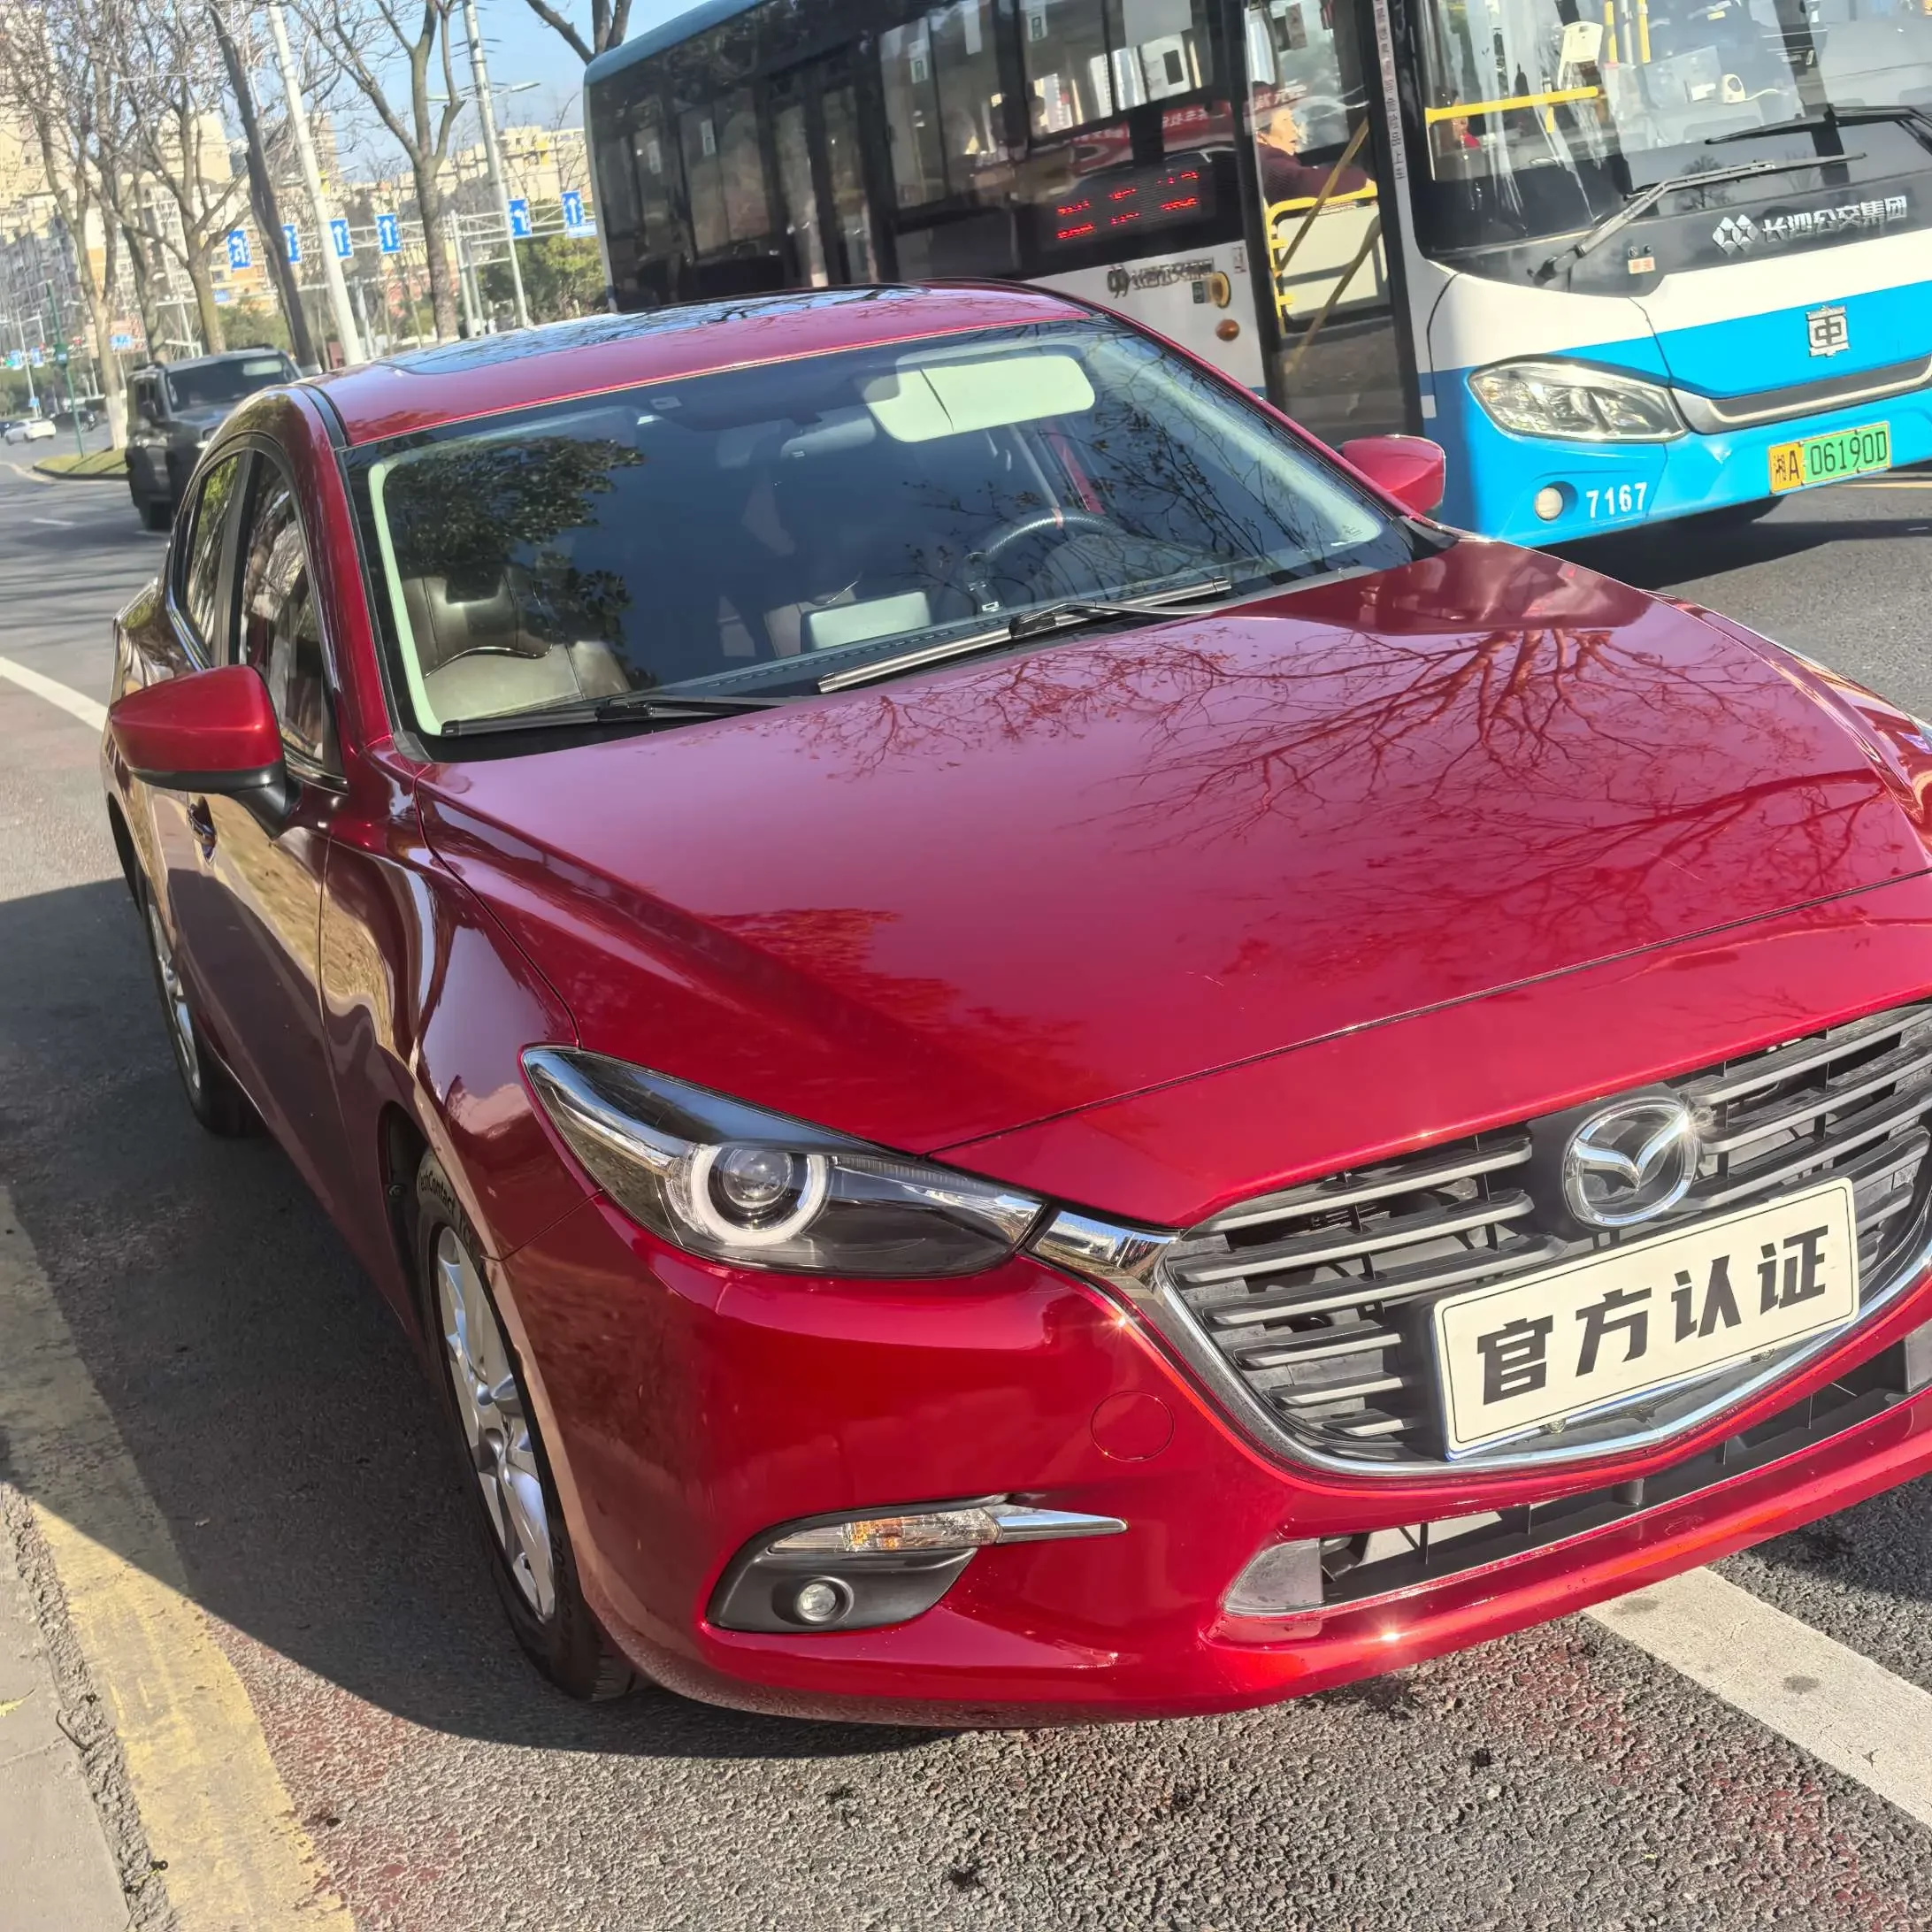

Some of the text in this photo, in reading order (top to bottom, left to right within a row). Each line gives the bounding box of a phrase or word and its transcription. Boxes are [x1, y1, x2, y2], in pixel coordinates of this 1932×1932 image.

[1762, 196, 1907, 242] 长沙公交集团
[1586, 482, 1648, 518] 7167
[1477, 1224, 1828, 1406] 官方认证
